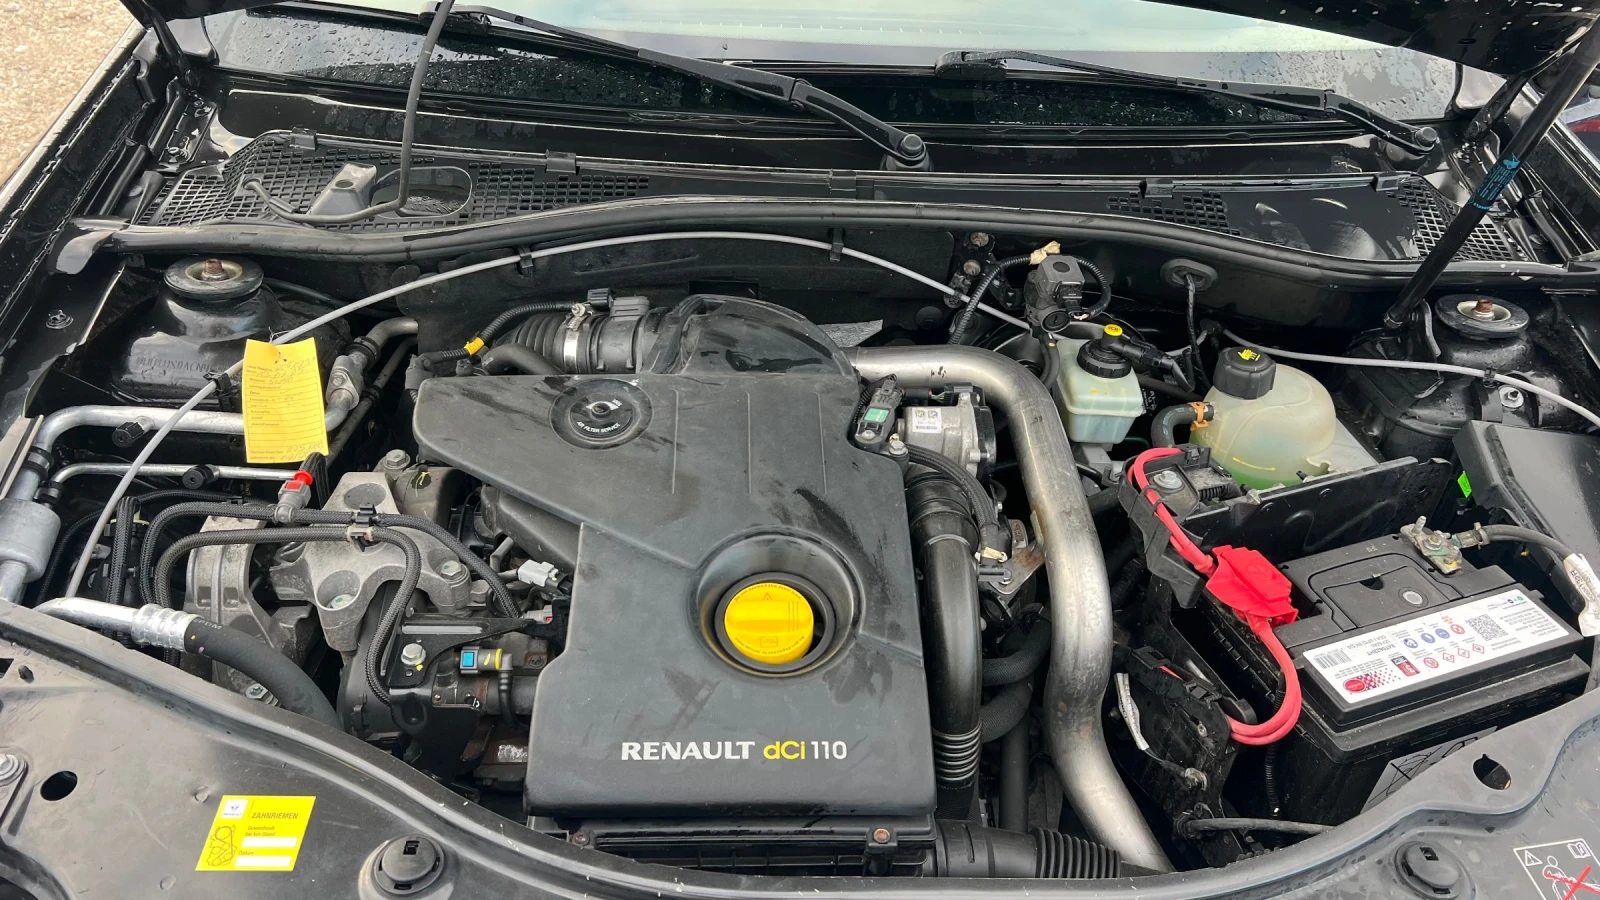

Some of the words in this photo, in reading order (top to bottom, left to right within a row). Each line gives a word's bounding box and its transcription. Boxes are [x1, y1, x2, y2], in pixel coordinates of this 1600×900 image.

[584, 425, 600, 433] FILTER
[601, 422, 621, 433] SERVICE
[621, 741, 755, 761] RENAULT
[763, 740, 806, 760] dCi
[811, 740, 848, 760] 110
